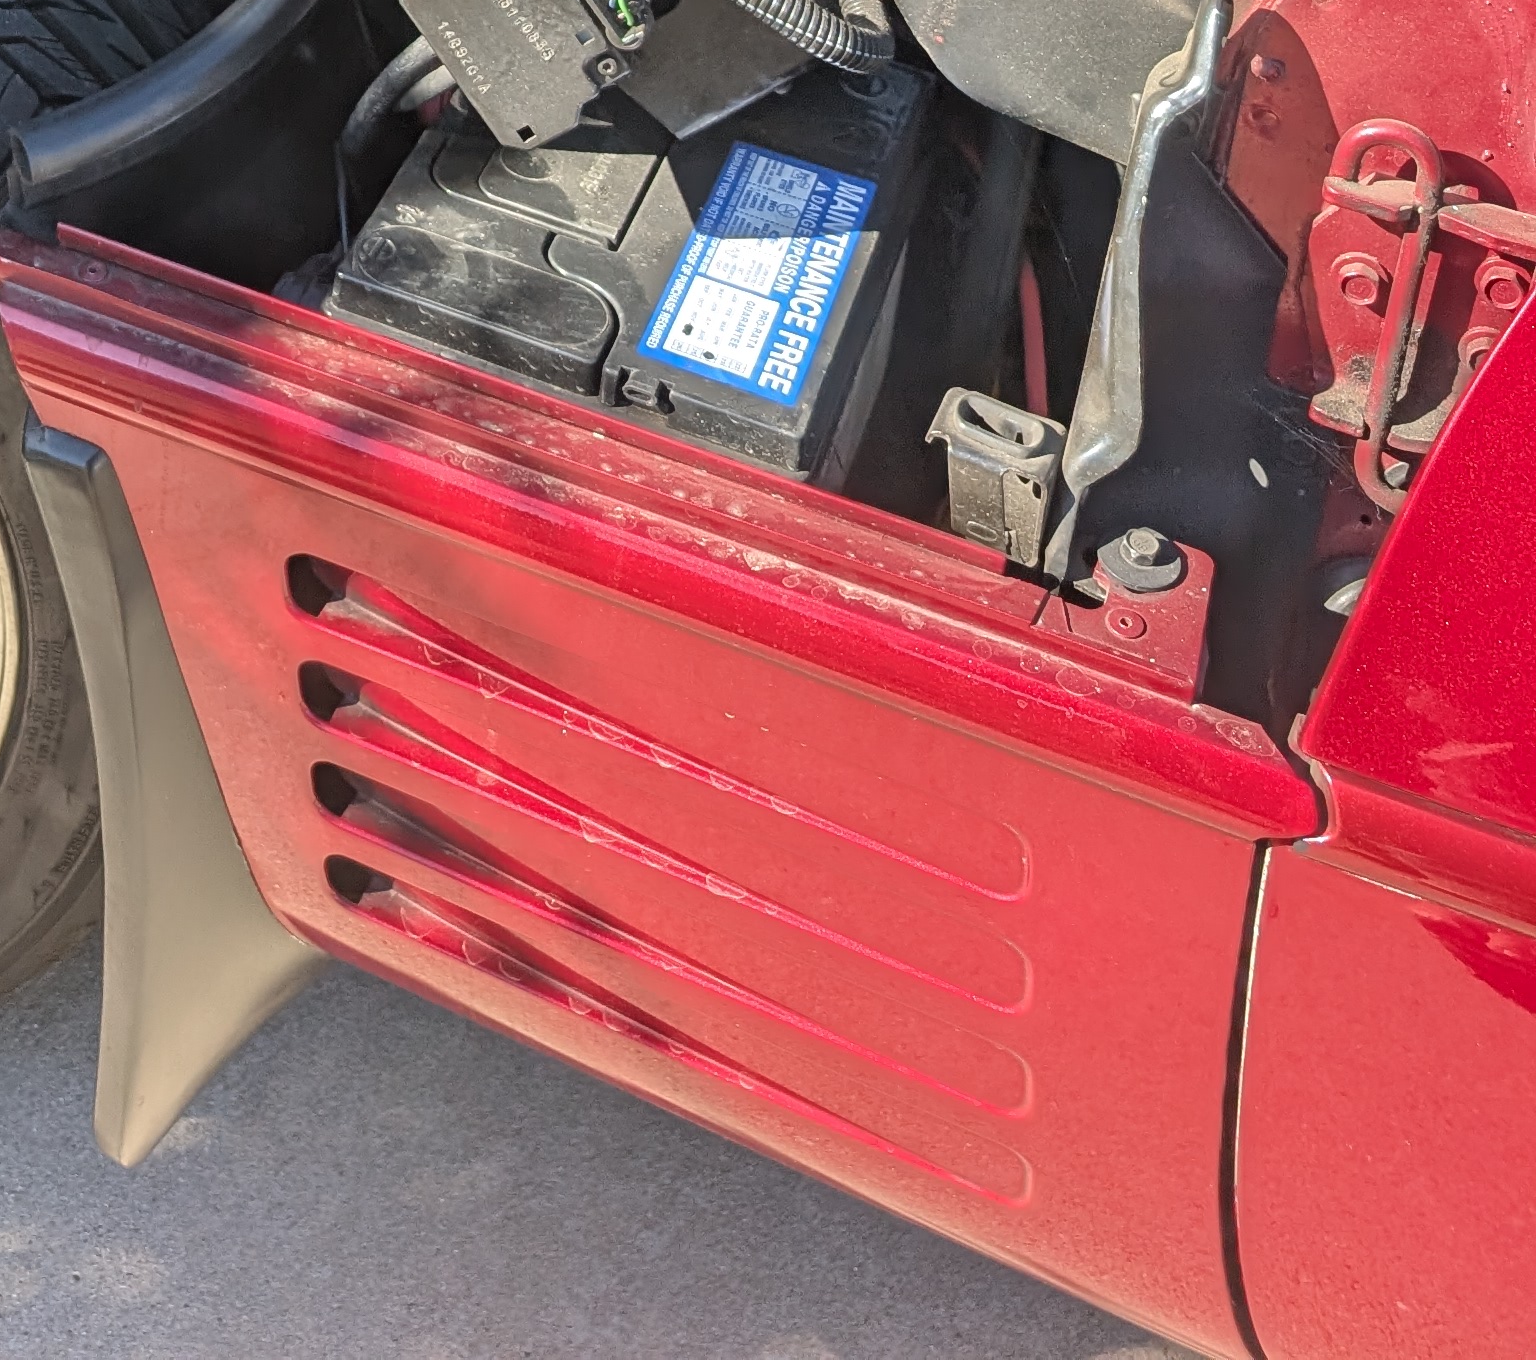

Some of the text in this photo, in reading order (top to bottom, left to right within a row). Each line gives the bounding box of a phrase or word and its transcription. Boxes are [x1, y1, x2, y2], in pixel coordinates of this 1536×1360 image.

[766, 198, 778, 213] NO
[644, 145, 747, 350] WARRANTY VOID IF NOT DATED-PROOF OF PURCHASE REQUIRED
[773, 195, 824, 295] DANGER/POISON
[782, 180, 867, 333] MAINTENANCE
[727, 299, 756, 349] GUARANTEE
[745, 309, 770, 350] PRO-RATA
[755, 327, 809, 397] FREE
